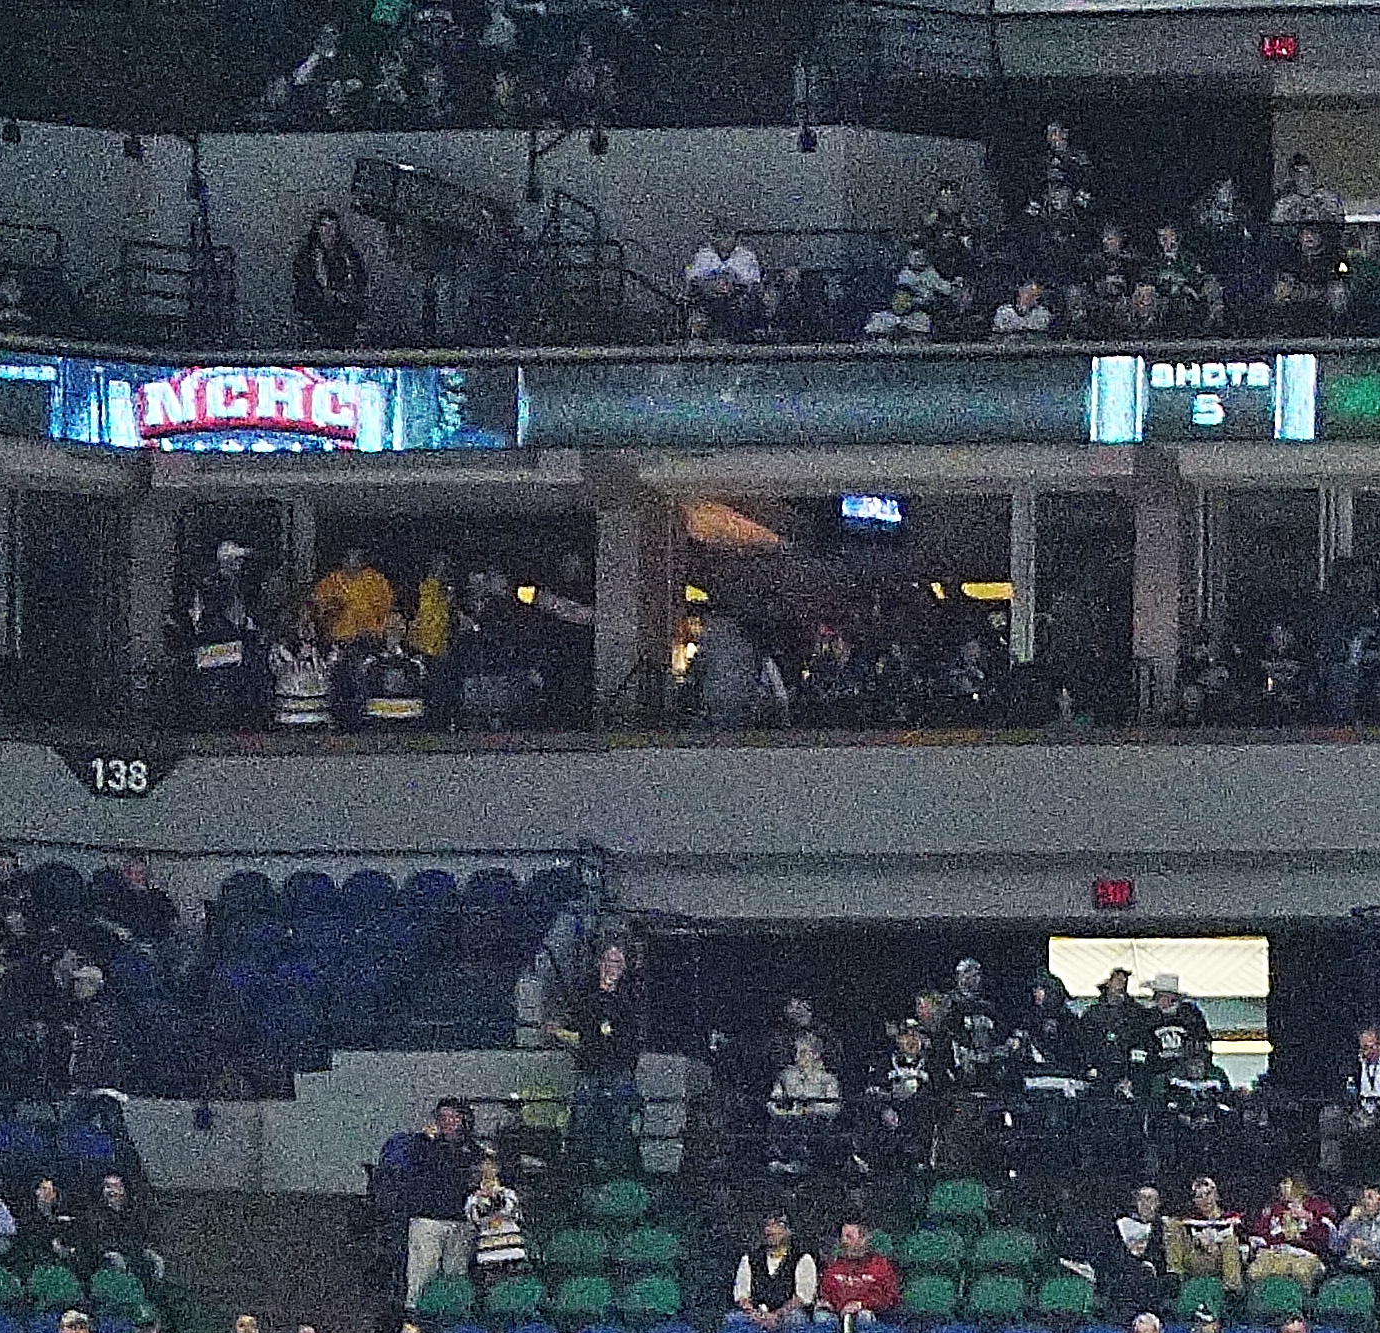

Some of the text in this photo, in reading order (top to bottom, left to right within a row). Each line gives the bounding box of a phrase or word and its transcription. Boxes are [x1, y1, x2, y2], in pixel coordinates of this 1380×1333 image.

[1150, 361, 1270, 387] SHOTS
[144, 377, 358, 427] NCHC
[90, 758, 149, 793] 138
